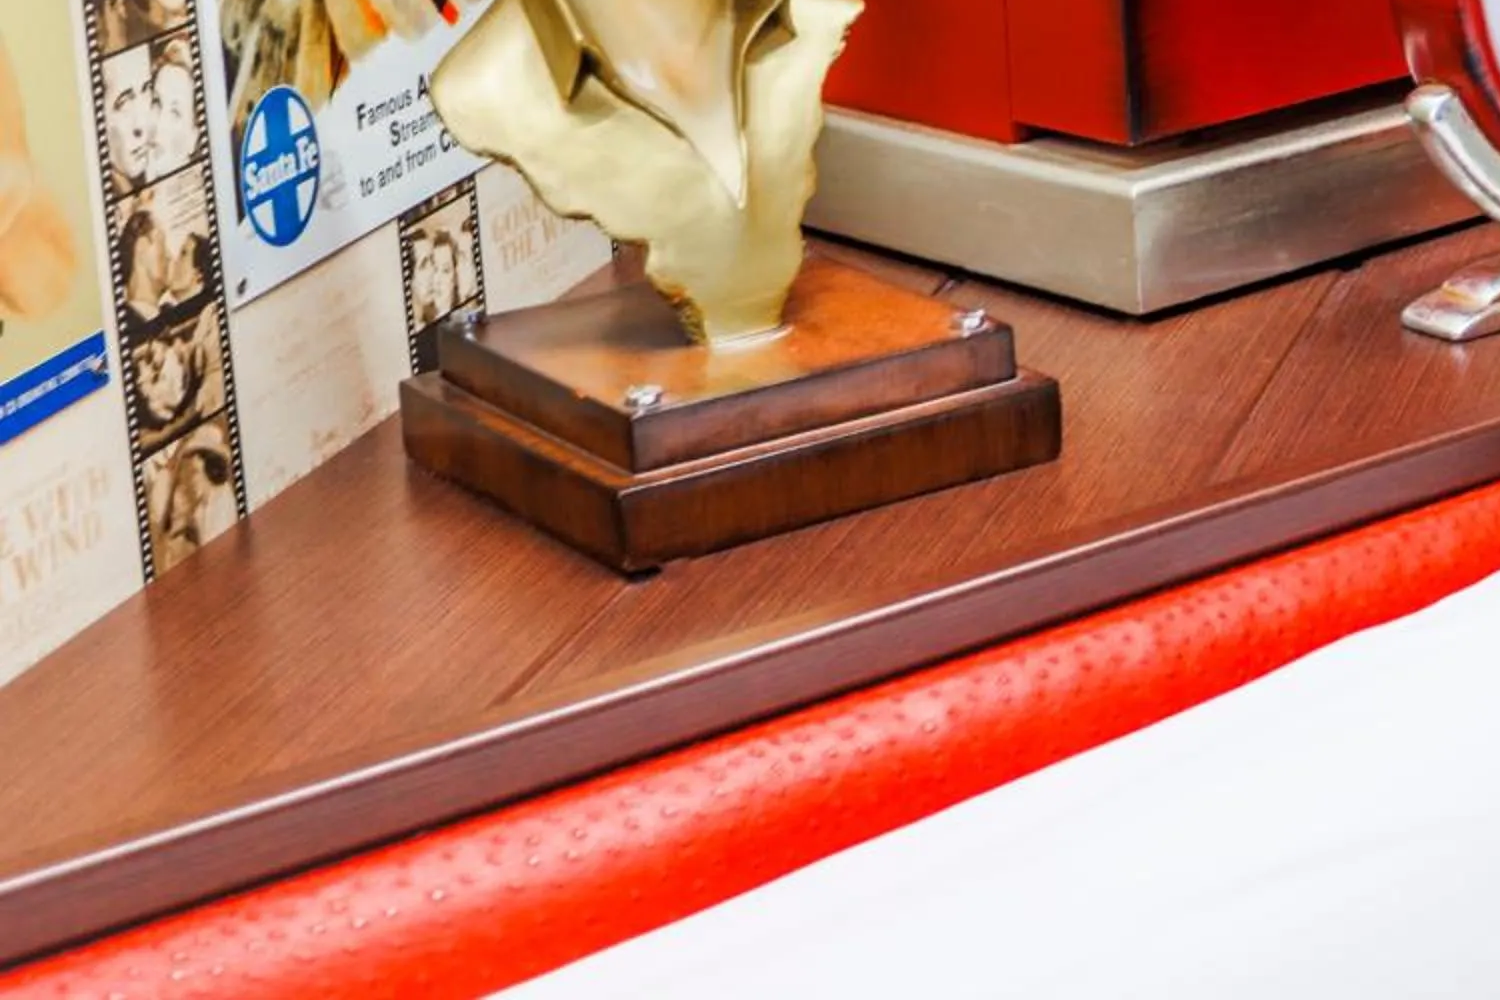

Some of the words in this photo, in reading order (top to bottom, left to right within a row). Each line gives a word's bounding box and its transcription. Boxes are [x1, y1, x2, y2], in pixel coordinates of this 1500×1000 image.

[356, 87, 413, 131] Famous
[245, 151, 298, 199] Santa
[295, 134, 320, 170] Fe
[360, 176, 375, 198] to
[377, 156, 404, 188] and
[406, 143, 438, 173] from
